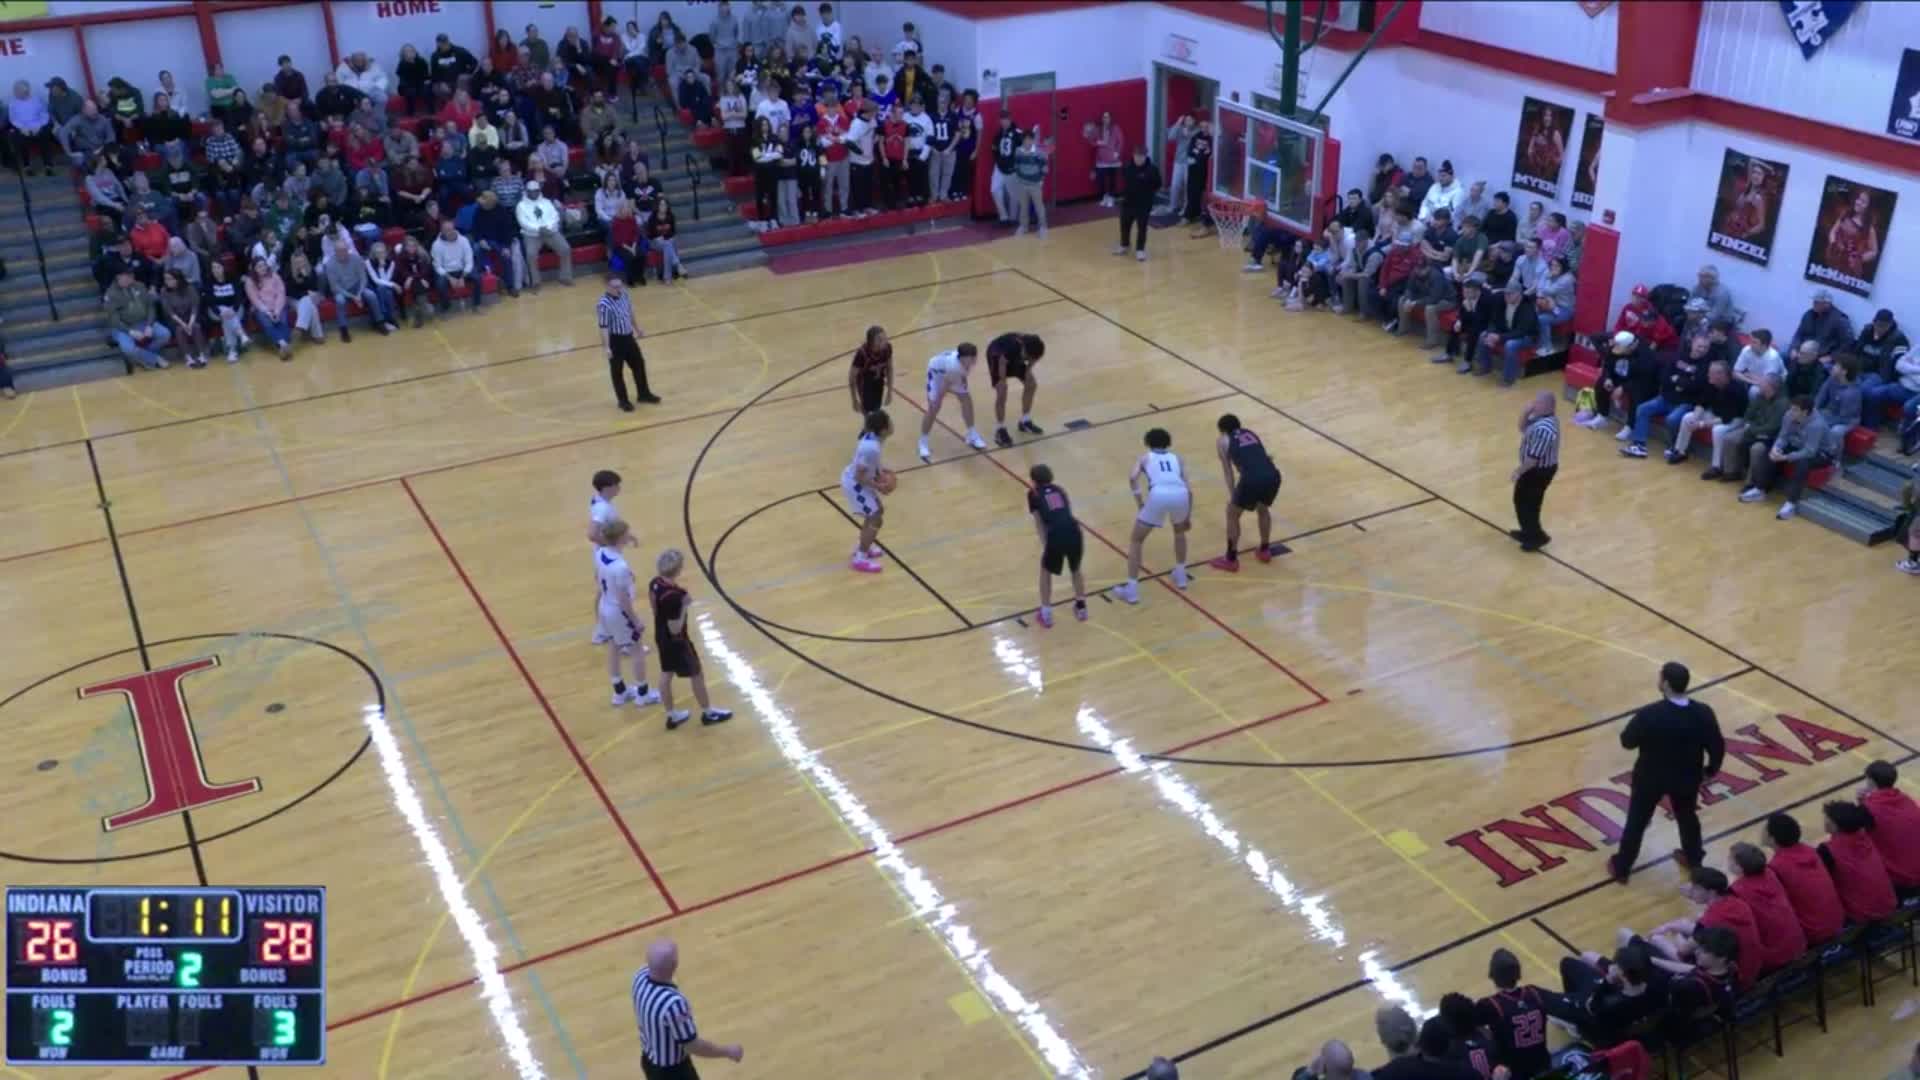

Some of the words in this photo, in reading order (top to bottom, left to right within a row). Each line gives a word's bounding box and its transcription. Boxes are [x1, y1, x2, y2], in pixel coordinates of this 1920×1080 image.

[376, 0, 441, 18] HOME
[1711, 232, 1768, 261] FINZEL
[1159, 460, 1173, 473] 11
[1445, 713, 1869, 888] INDANA
[1512, 1009, 1544, 1048] 22
